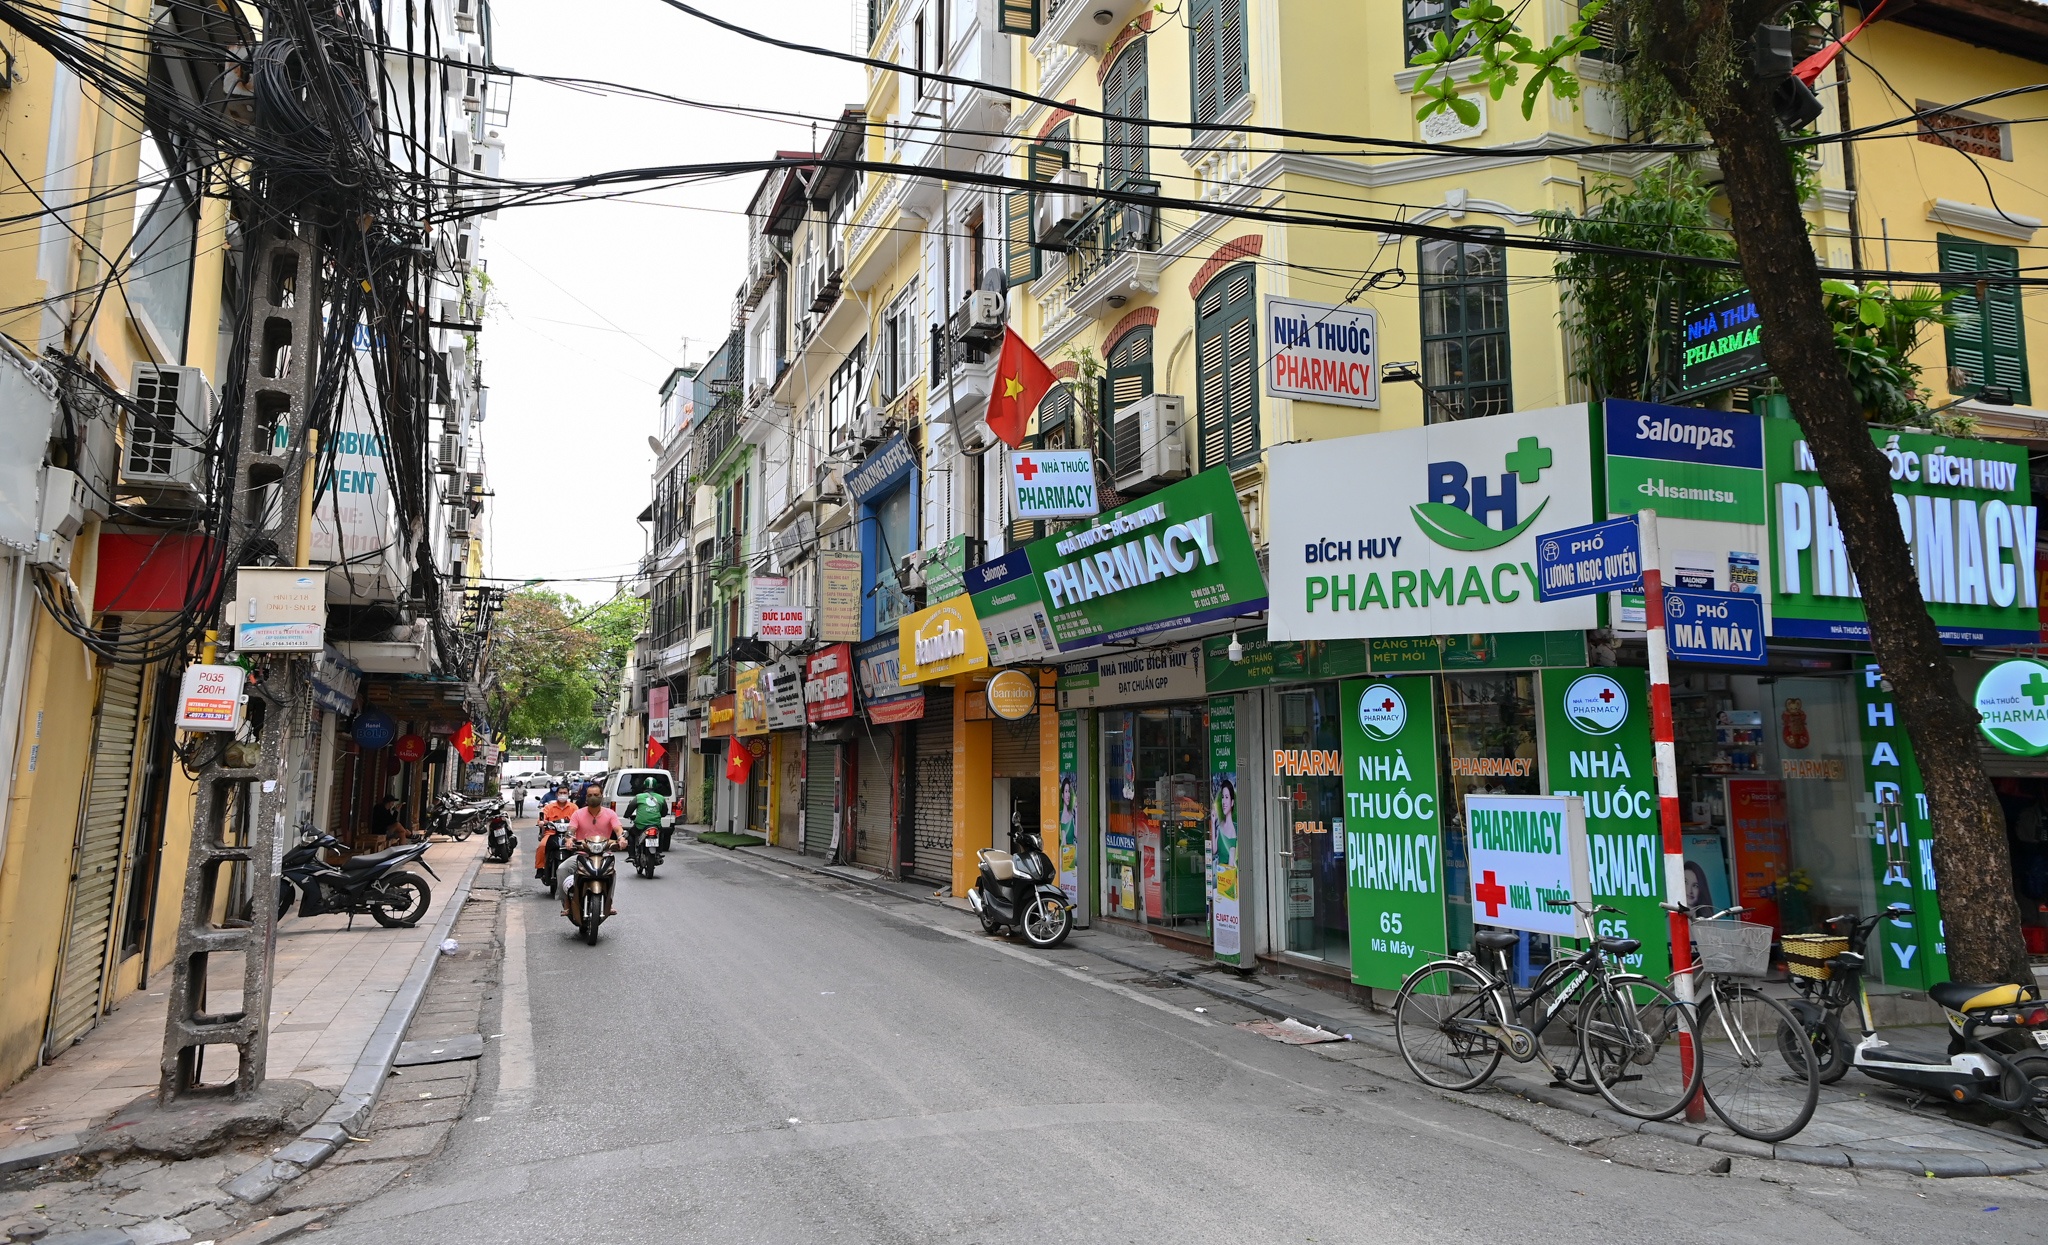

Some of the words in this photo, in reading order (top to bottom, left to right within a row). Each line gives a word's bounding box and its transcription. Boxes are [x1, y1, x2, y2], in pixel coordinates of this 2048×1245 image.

[1274, 314, 1308, 348] NHÀ
[1315, 317, 1370, 356] THUỐC
[1688, 312, 1718, 341] NHÀ
[1276, 353, 1370, 396] PHARMACY
[1636, 415, 1734, 450] Salonpas
[850, 459, 887, 498] BOOKING
[881, 439, 912, 475] OFFICE
[1041, 459, 1060, 473] NHÀ
[1060, 457, 1090, 472] THUỐC
[1922, 445, 1975, 488] BÍCH
[1974, 459, 2018, 492] HUY
[1018, 485, 1092, 510] PHARMACY
[1428, 460, 1518, 531] BH
[1638, 478, 1734, 503] Hisamitsu
[1056, 531, 1076, 557] NHÀ
[1076, 518, 1114, 549] THUỐC
[1110, 511, 1139, 536] BÍCH
[1138, 502, 1166, 526] HUY
[1305, 537, 1352, 564] BÍCH
[1358, 536, 1402, 559] HUY
[1571, 531, 1604, 554] PHỐ
[1774, 482, 2038, 608] PHMACY
[1044, 513, 1219, 609] PHARMACY
[1545, 563, 1575, 589] LƯƠNG
[1576, 558, 1602, 586] NGỌC
[1604, 546, 1637, 580] QUYẾN
[982, 564, 1008, 582] Salonpas
[1730, 575, 1758, 584] FEVER
[762, 608, 778, 620] ĐỨC
[780, 612, 802, 620] LONG
[1696, 601, 1728, 618] PHỐ
[1675, 620, 1707, 648] MÃ
[1711, 622, 1753, 652] MÂY
[1830, 626, 1842, 634] NHÀ
[1843, 626, 1862, 635] THUỐC
[1960, 632, 1972, 642] VIỆT
[1972, 632, 1984, 640] NAM
[1064, 661, 1089, 675] Salonpas
[1100, 661, 1116, 677] NHÀ
[1118, 655, 1144, 675] THUỐC
[1170, 652, 1188, 668] HUY
[1374, 652, 1398, 663] MỆT
[199, 672, 224, 682] P035
[872, 662, 887, 685] APT
[197, 685, 225, 694] 280/H
[1119, 682, 1132, 696] ĐẠT
[1155, 677, 1168, 689] GPP
[1211, 706, 1234, 716] PHARMACY
[1983, 710, 2048, 723] PHARMA
[357, 729, 388, 738] BOLD
[1211, 720, 1220, 730] NHÀ
[1219, 761, 1227, 769] GPP
[1273, 750, 1344, 776] PHARM
[1359, 748, 1412, 781] NHÀ
[1451, 757, 1532, 777] PHARMACY
[1570, 743, 1631, 778] NHÀ
[1781, 759, 1844, 779] PHARMACY
[1348, 788, 1434, 820] THUỐC
[1295, 821, 1327, 834] PULL
[1470, 809, 1562, 855] PHARMACY
[1107, 835, 1135, 849] SALONPAS
[1348, 832, 1437, 893] PHARMACY
[1510, 881, 1532, 910] NHÀ
[1536, 880, 1571, 915] THUỐC
[1380, 912, 1403, 934] 65
[1598, 919, 1629, 940] 65
[1371, 938, 1387, 952] Mã
[1390, 938, 1415, 958] Mây
